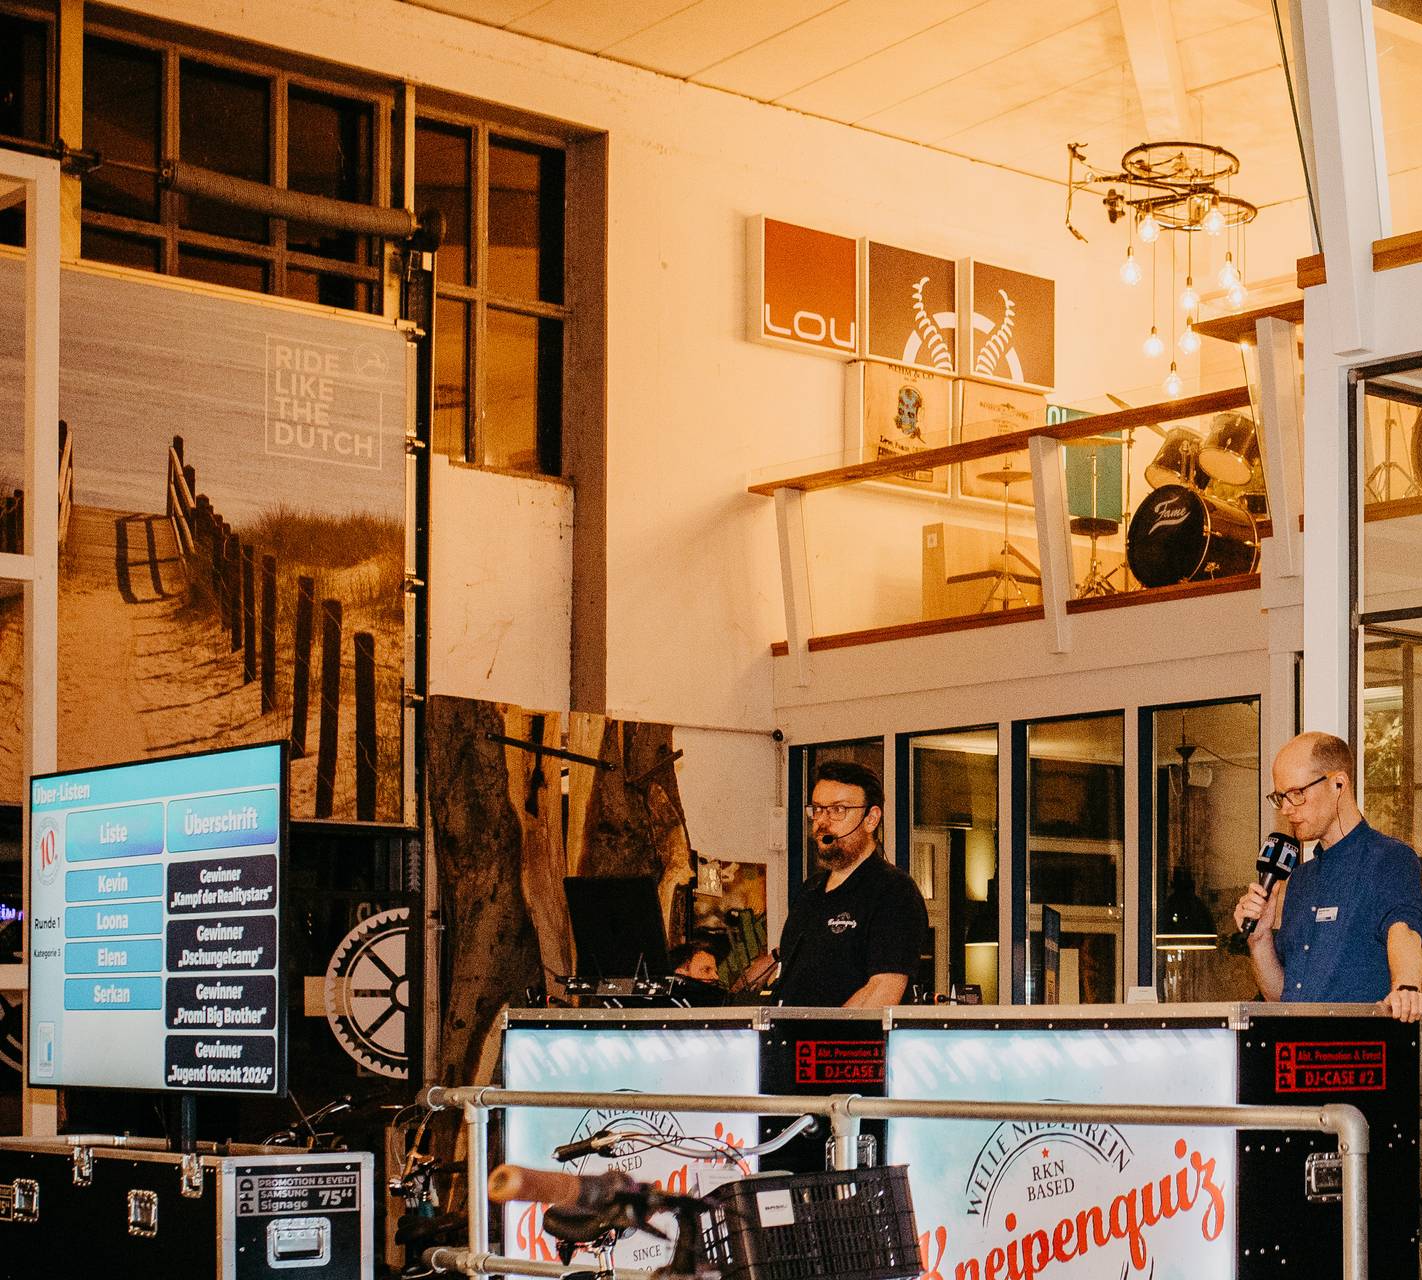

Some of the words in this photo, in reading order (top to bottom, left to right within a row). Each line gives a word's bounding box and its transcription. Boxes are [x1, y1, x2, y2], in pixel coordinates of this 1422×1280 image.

[765, 303, 856, 349] LOU
[275, 344, 340, 377] RIDE
[275, 370, 334, 401] LIKE
[274, 396, 330, 426] THE
[275, 421, 373, 457] DUTCH
[1154, 496, 1187, 521] Fame
[34, 782, 90, 805] Über-Listen
[184, 807, 258, 836] Überschrift
[100, 823, 128, 844] Liste
[98, 872, 129, 893] Kevin
[200, 866, 242, 884] Gewinner
[202, 889, 217, 904] der
[34, 918, 56, 931] Runde
[96, 912, 129, 930] Loona
[196, 922, 244, 942] Gewinner
[33, 949, 57, 959] Kategorie
[97, 948, 128, 967] Elena
[94, 984, 130, 1003] Serkan
[195, 981, 243, 1000] Gewinner
[206, 1005, 223, 1028] Big
[195, 1040, 243, 1058] Gewinner
[834, 1048, 871, 1057] Promotion
[1297, 1051, 1312, 1061] Abt.
[1315, 1050, 1352, 1061] Promotion
[1354, 1050, 1361, 1060] &
[1362, 1050, 1382, 1060] Event
[799, 1043, 812, 1080] PFD
[1280, 1046, 1292, 1088] PFD
[207, 1064, 241, 1083] forscht
[825, 1066, 874, 1079] DJ-CASE
[1305, 1071, 1355, 1087] DJ-CASE
[1359, 1070, 1375, 1085] #2
[615, 1141, 636, 1156] KN
[967, 1133, 1011, 1216] WELLE
[1032, 1160, 1065, 1181] RKN
[259, 1177, 316, 1188] PROMOTION
[318, 1177, 324, 1185] &
[326, 1176, 355, 1184] EVENT
[1027, 1177, 1075, 1202] BASED
[260, 1189, 309, 1199] SAMSUNG
[261, 1199, 309, 1211] Signage
[919, 1138, 1226, 1280] Kneipenquiz
[633, 1244, 662, 1262] SINCE
